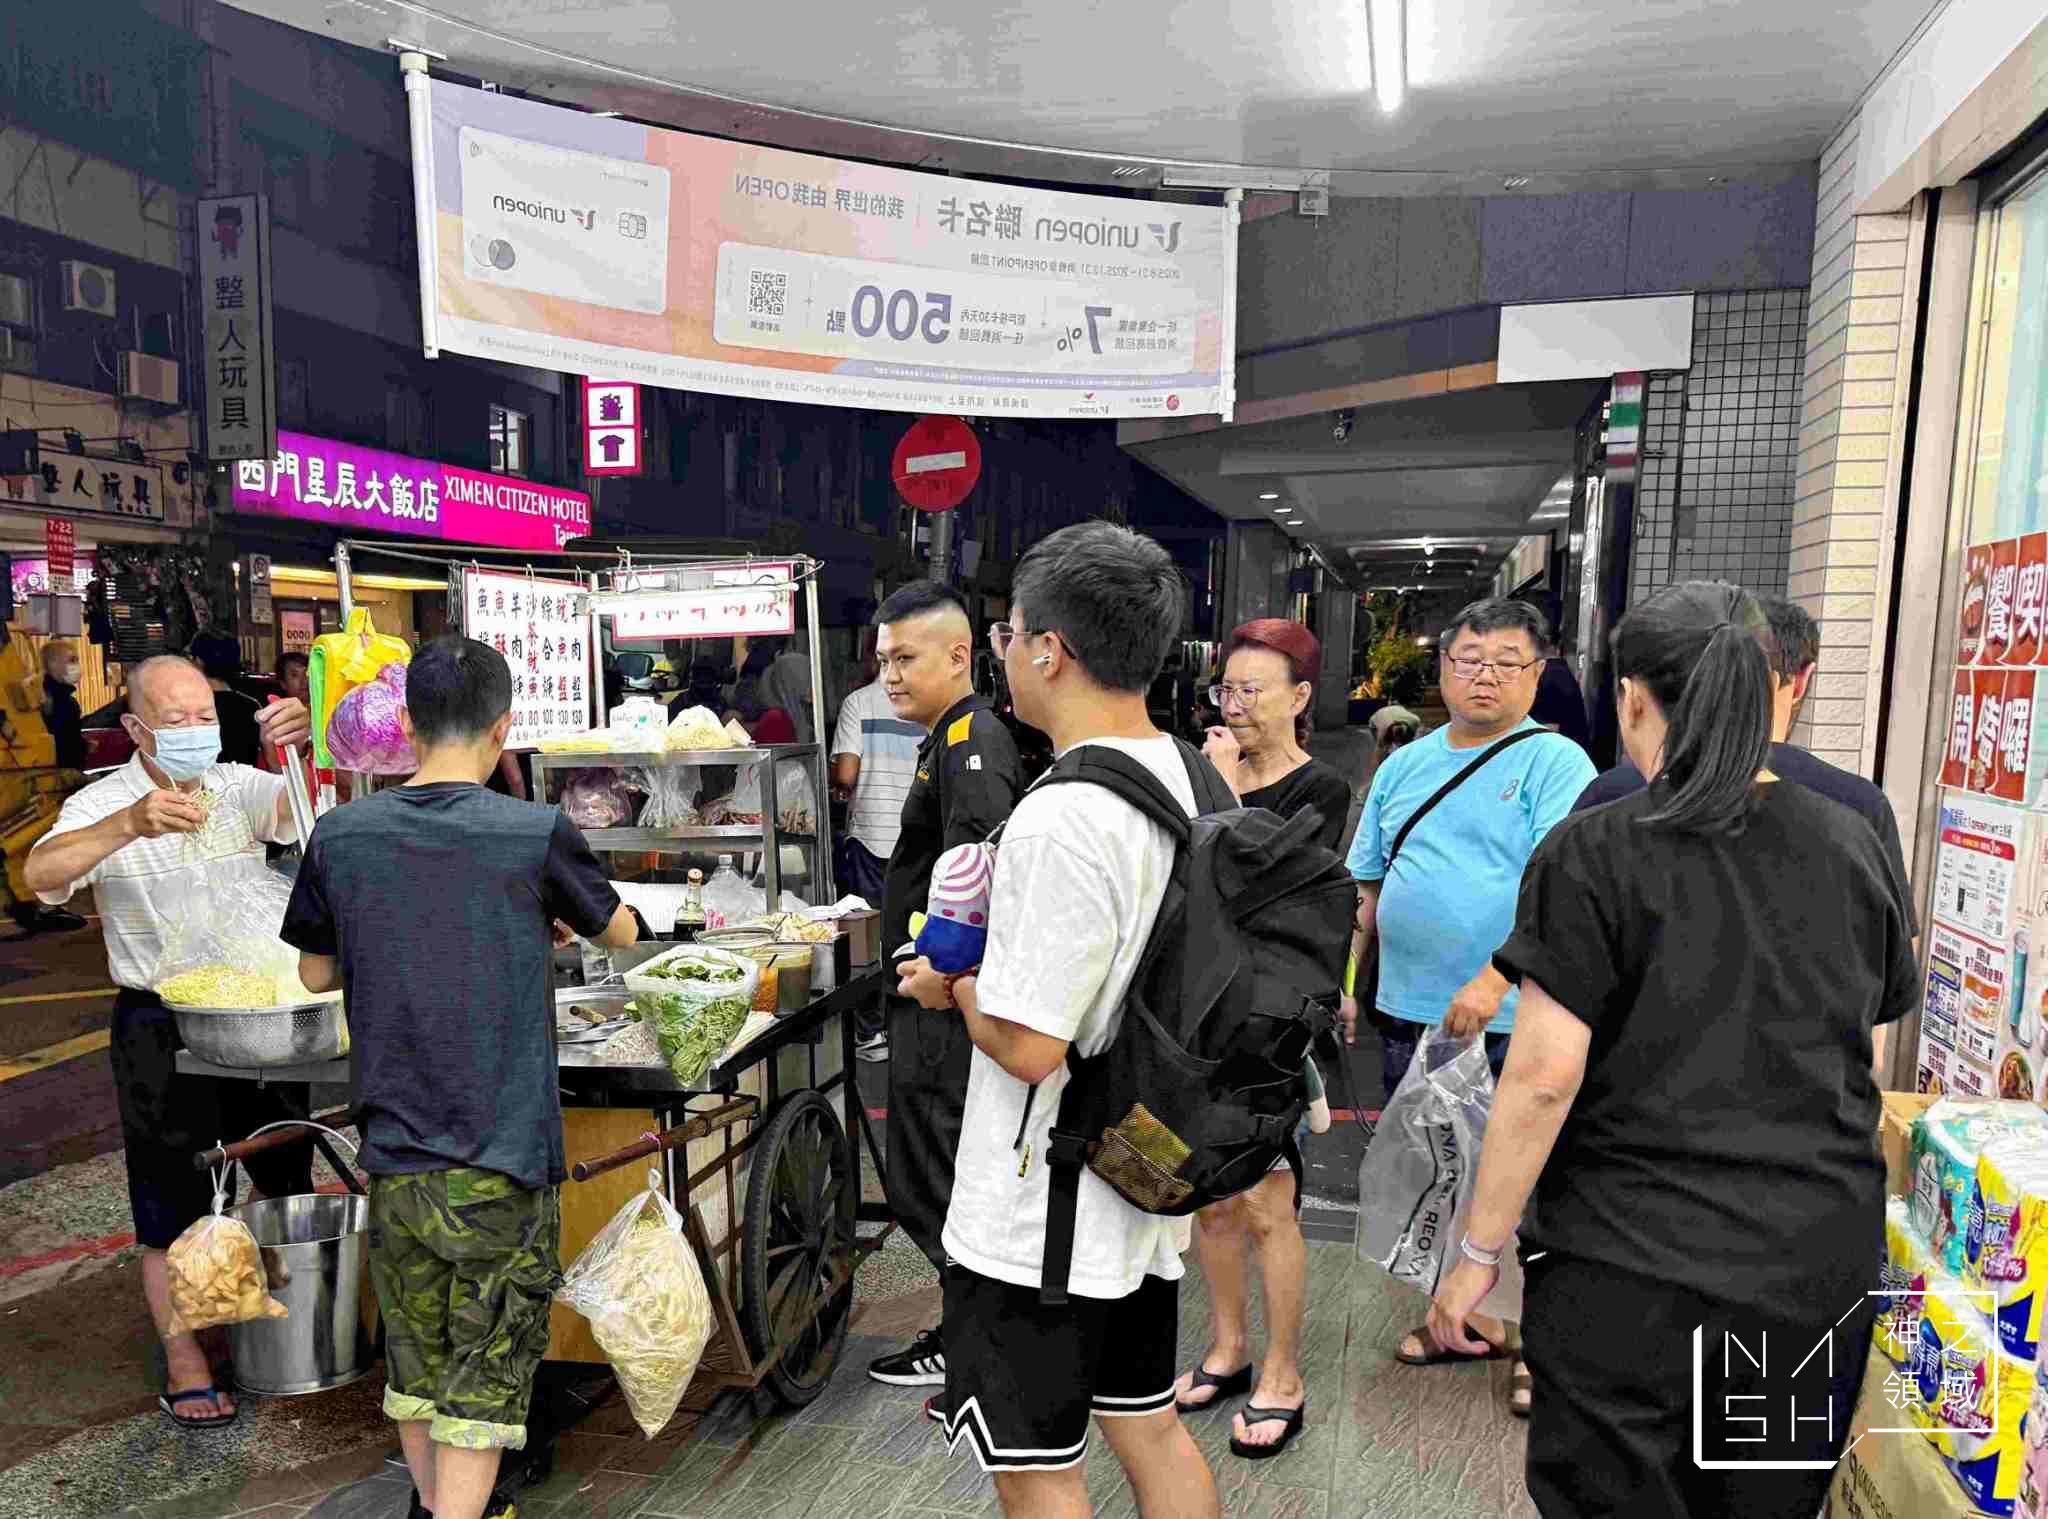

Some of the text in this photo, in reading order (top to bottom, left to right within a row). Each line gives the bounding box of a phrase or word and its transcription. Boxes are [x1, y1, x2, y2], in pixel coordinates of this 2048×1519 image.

[214, 275, 249, 431] 整人玩具
[238, 451, 440, 523] 西門星辰大飯店
[443, 474, 590, 524] XIMEN CITIZEN HOTEL
[528, 709, 539, 727] 80
[542, 708, 553, 725] 100
